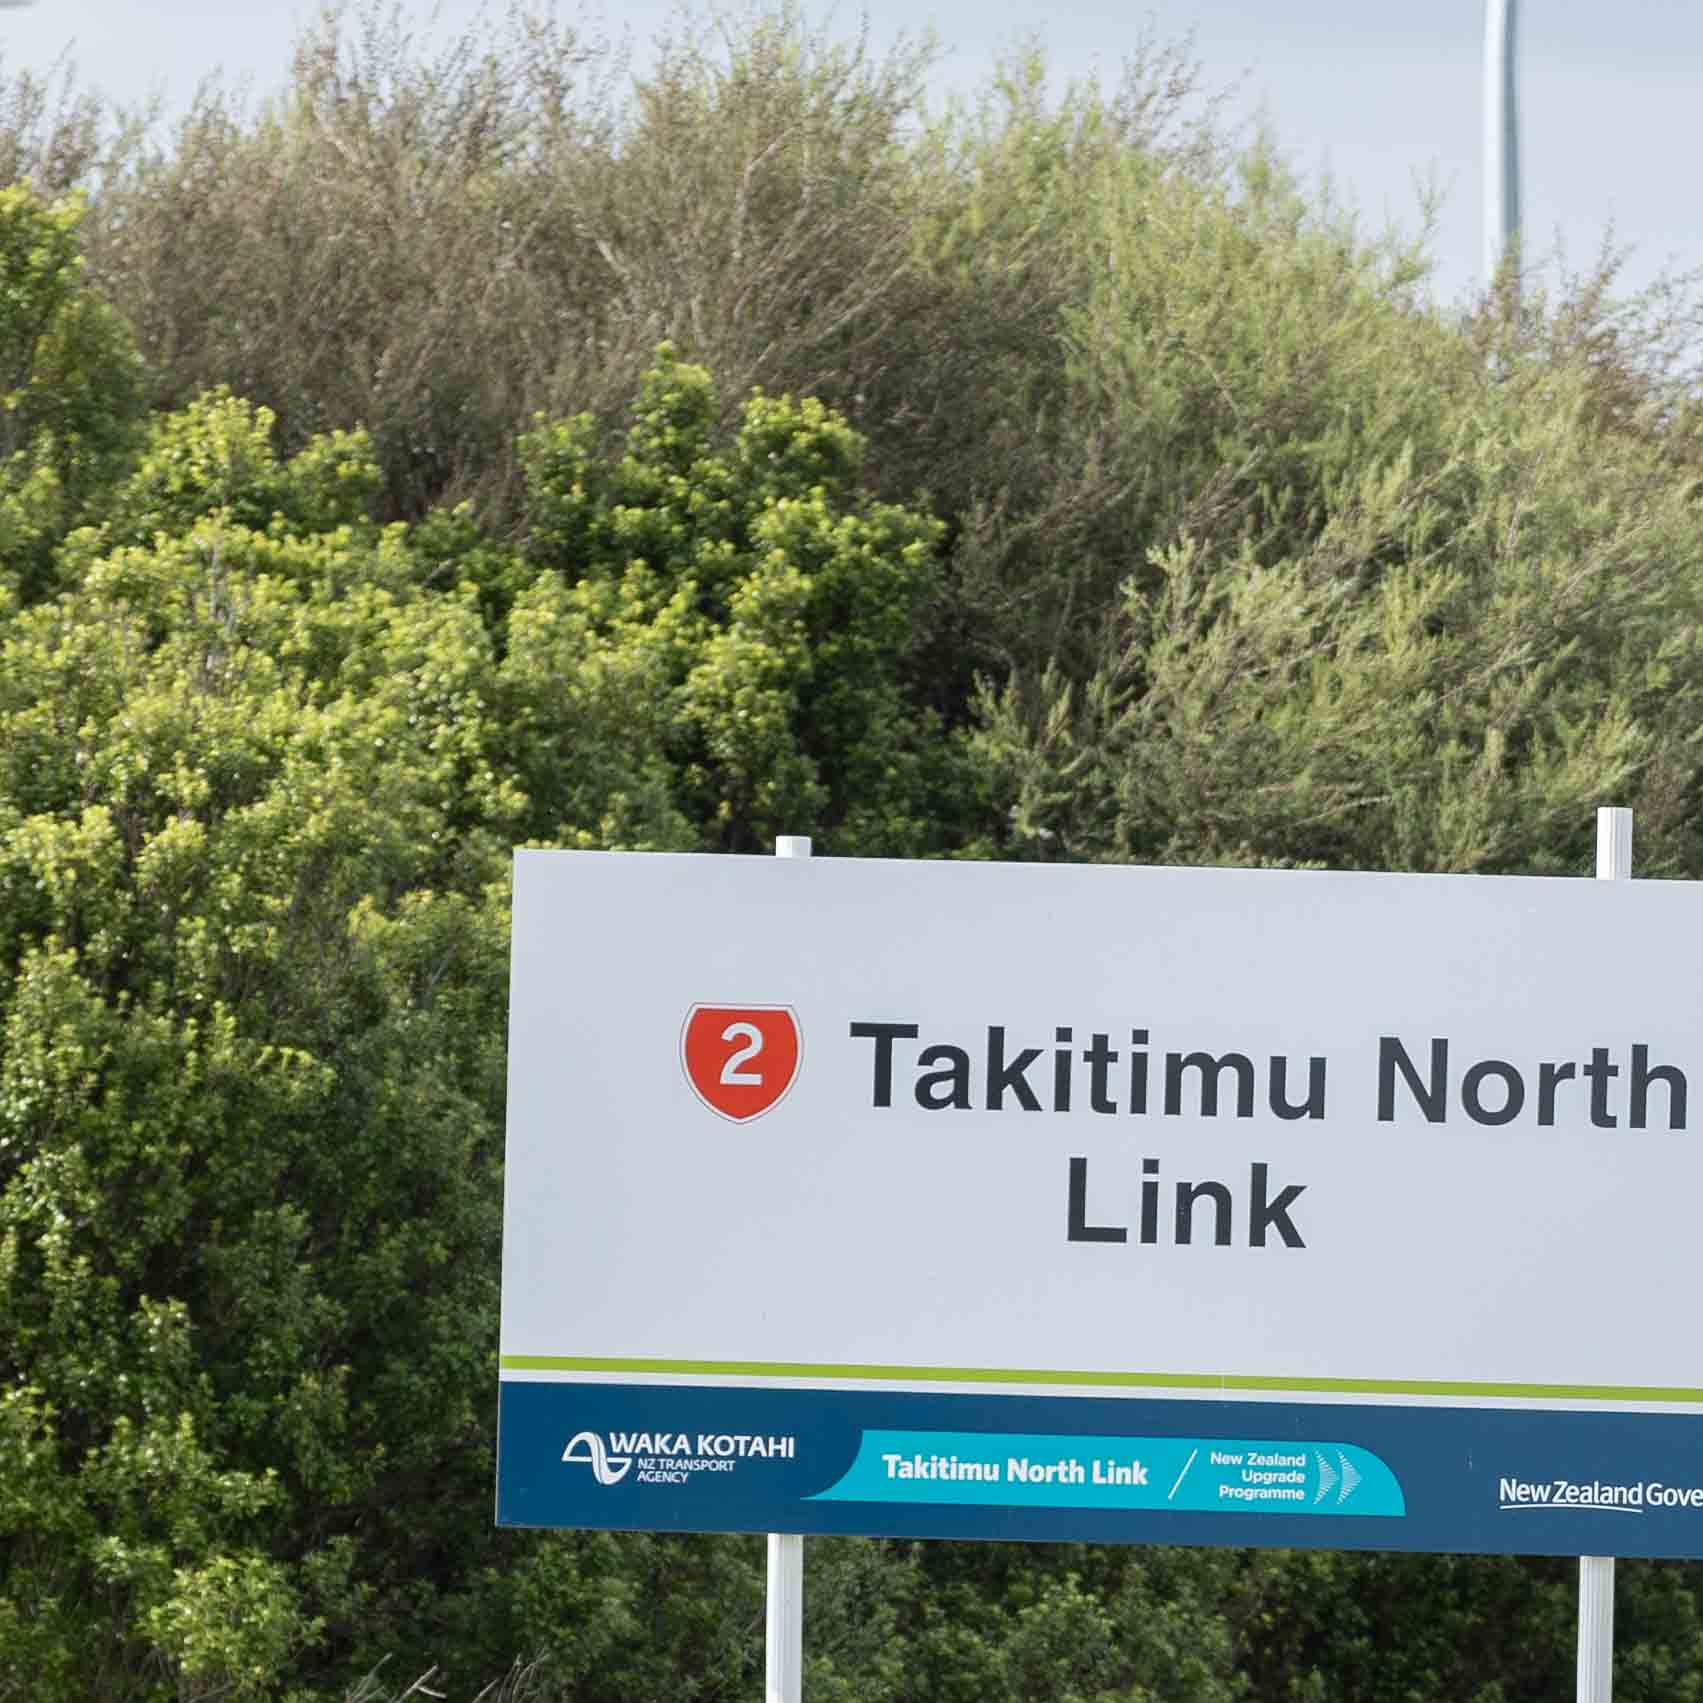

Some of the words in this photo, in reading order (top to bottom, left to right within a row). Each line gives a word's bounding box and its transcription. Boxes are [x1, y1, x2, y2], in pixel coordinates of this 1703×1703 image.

[720, 1022, 765, 1087] 2
[849, 1021, 1327, 1121] Takitimu
[1376, 1036, 1689, 1131] North
[1066, 1157, 1308, 1249] Link
[608, 1431, 692, 1456] WAKA
[697, 1434, 795, 1459] KOTAHI
[637, 1457, 656, 1471] NZ
[657, 1458, 736, 1473] TRANSPORT
[882, 1454, 1000, 1482] Takitimu
[1006, 1457, 1086, 1484] North
[1091, 1458, 1149, 1486] Link
[1209, 1451, 1244, 1466] New
[1246, 1452, 1306, 1468] Zealand
[636, 1470, 690, 1484] AGENCY
[1241, 1468, 1306, 1487] Upgrade
[1218, 1484, 1306, 1502] Programme
[1499, 1478, 1551, 1503] New
[1551, 1480, 1644, 1506] Zealand
